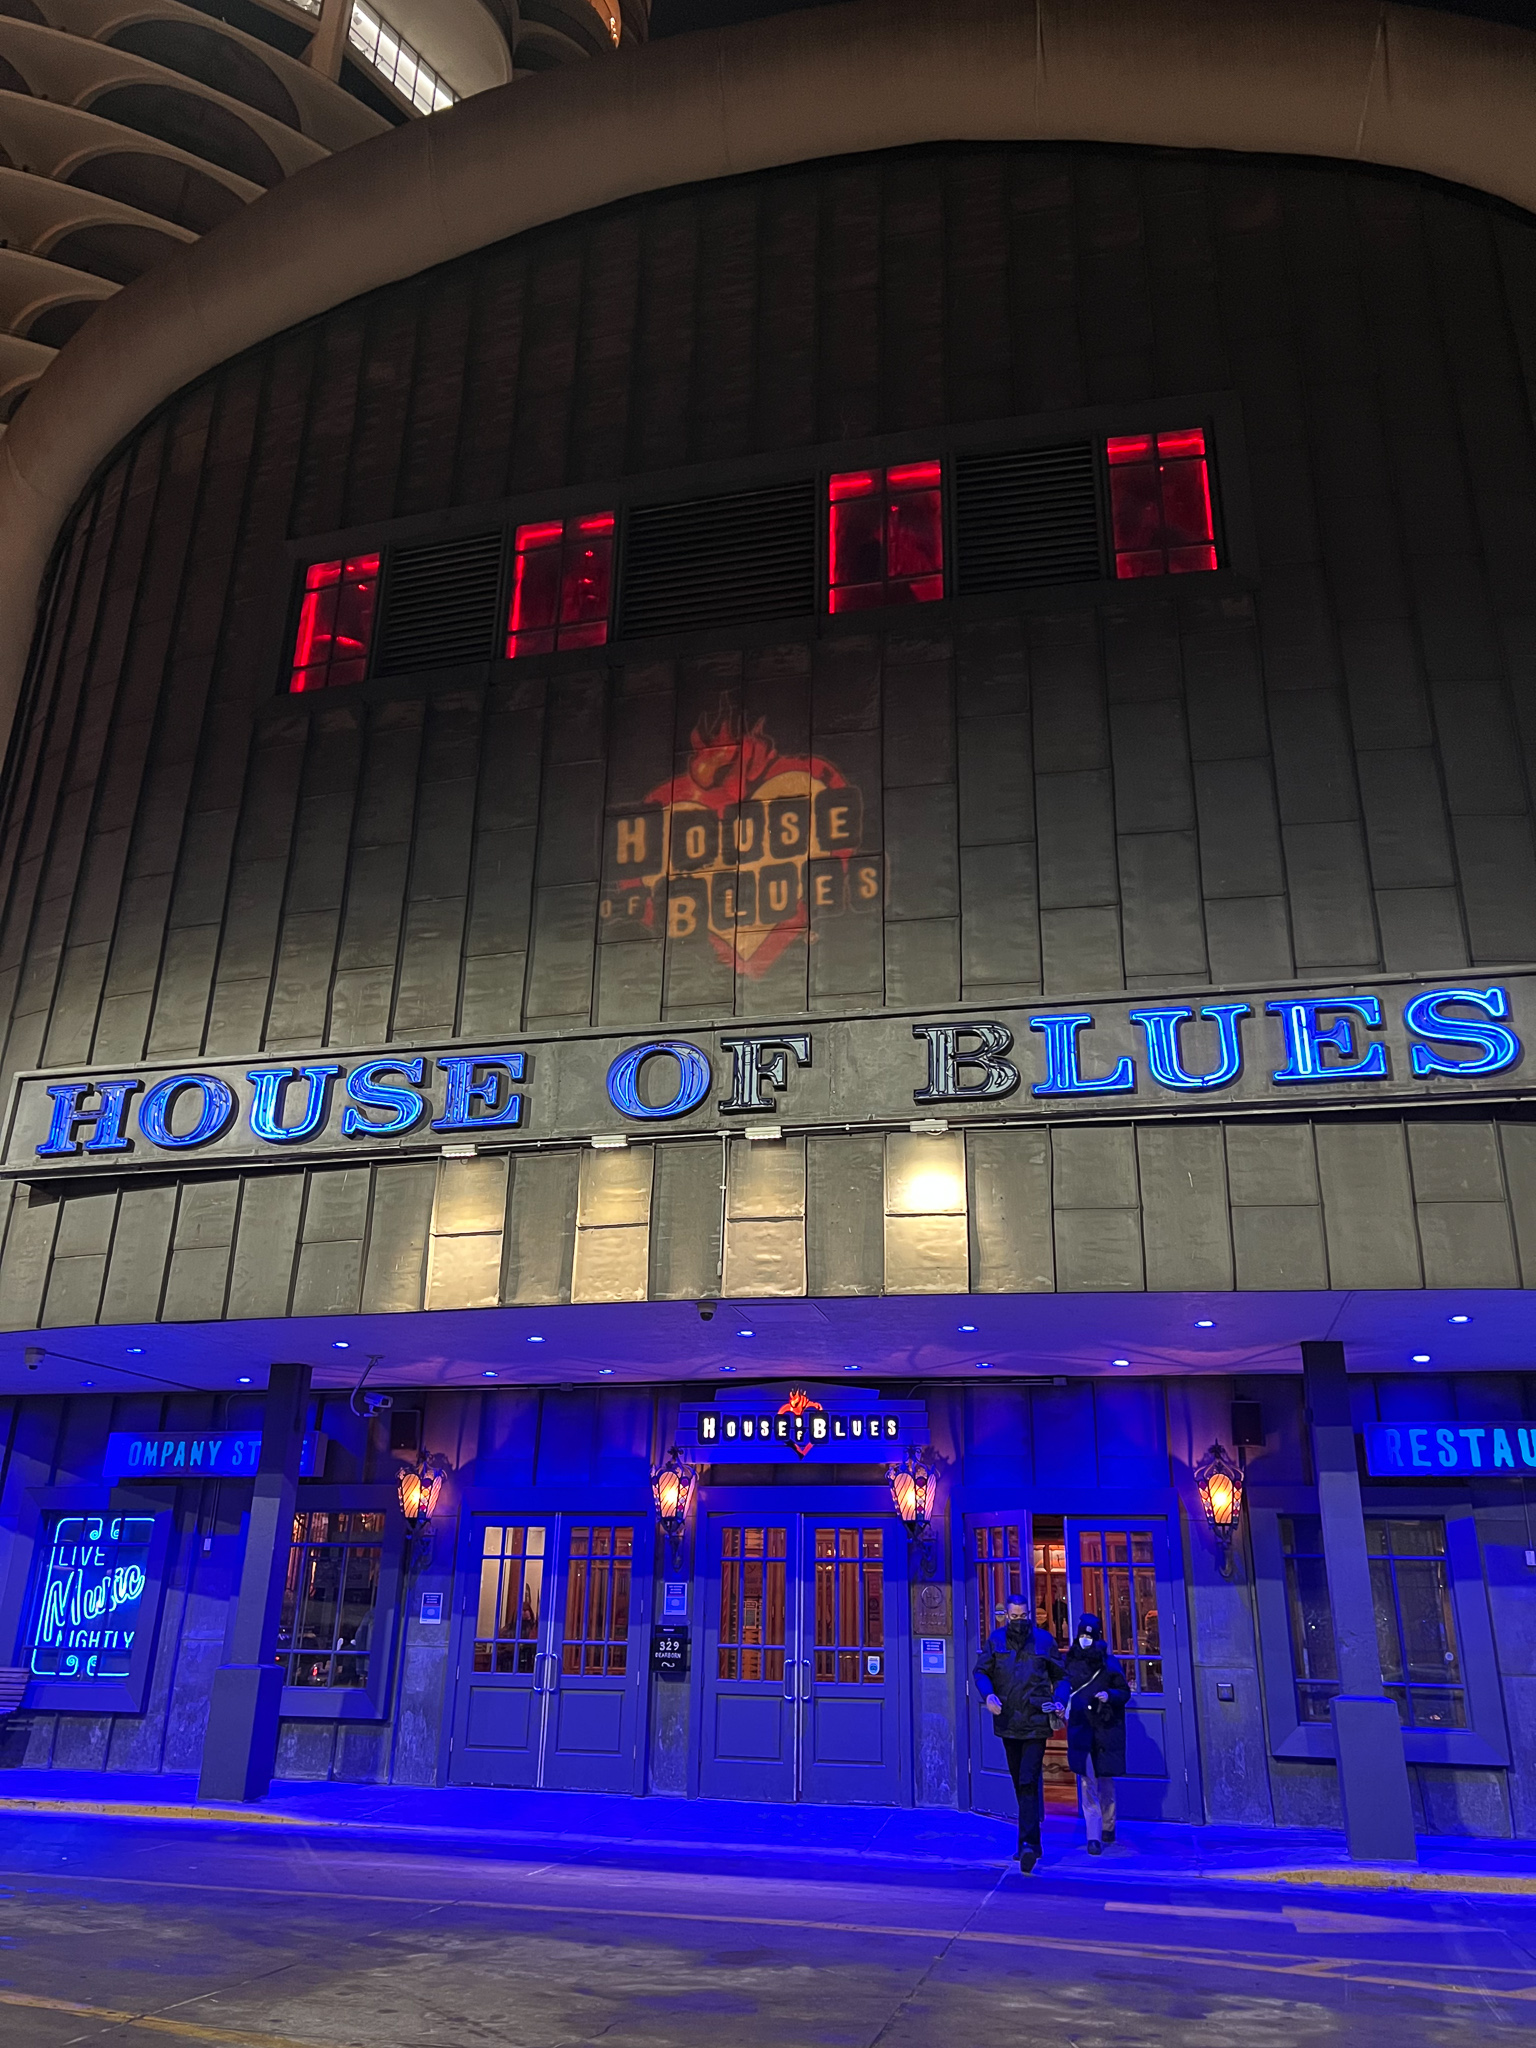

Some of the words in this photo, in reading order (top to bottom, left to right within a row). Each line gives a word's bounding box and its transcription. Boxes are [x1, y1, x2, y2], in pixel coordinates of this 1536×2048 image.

[616, 806, 849, 864] HOUSE
[600, 896, 640, 918] OF
[667, 867, 878, 938] BLUES
[36, 1051, 527, 1157] HOUSE
[606, 1032, 813, 1122] OF
[912, 986, 1521, 1104] BLUES
[703, 1417, 788, 1439] HOUSE
[813, 1417, 897, 1439] BLUES
[1384, 1428, 1536, 1468] RESTAU
[58, 1546, 105, 1566] LIVE
[43, 1564, 146, 1642] Music
[659, 1641, 680, 1651] 329
